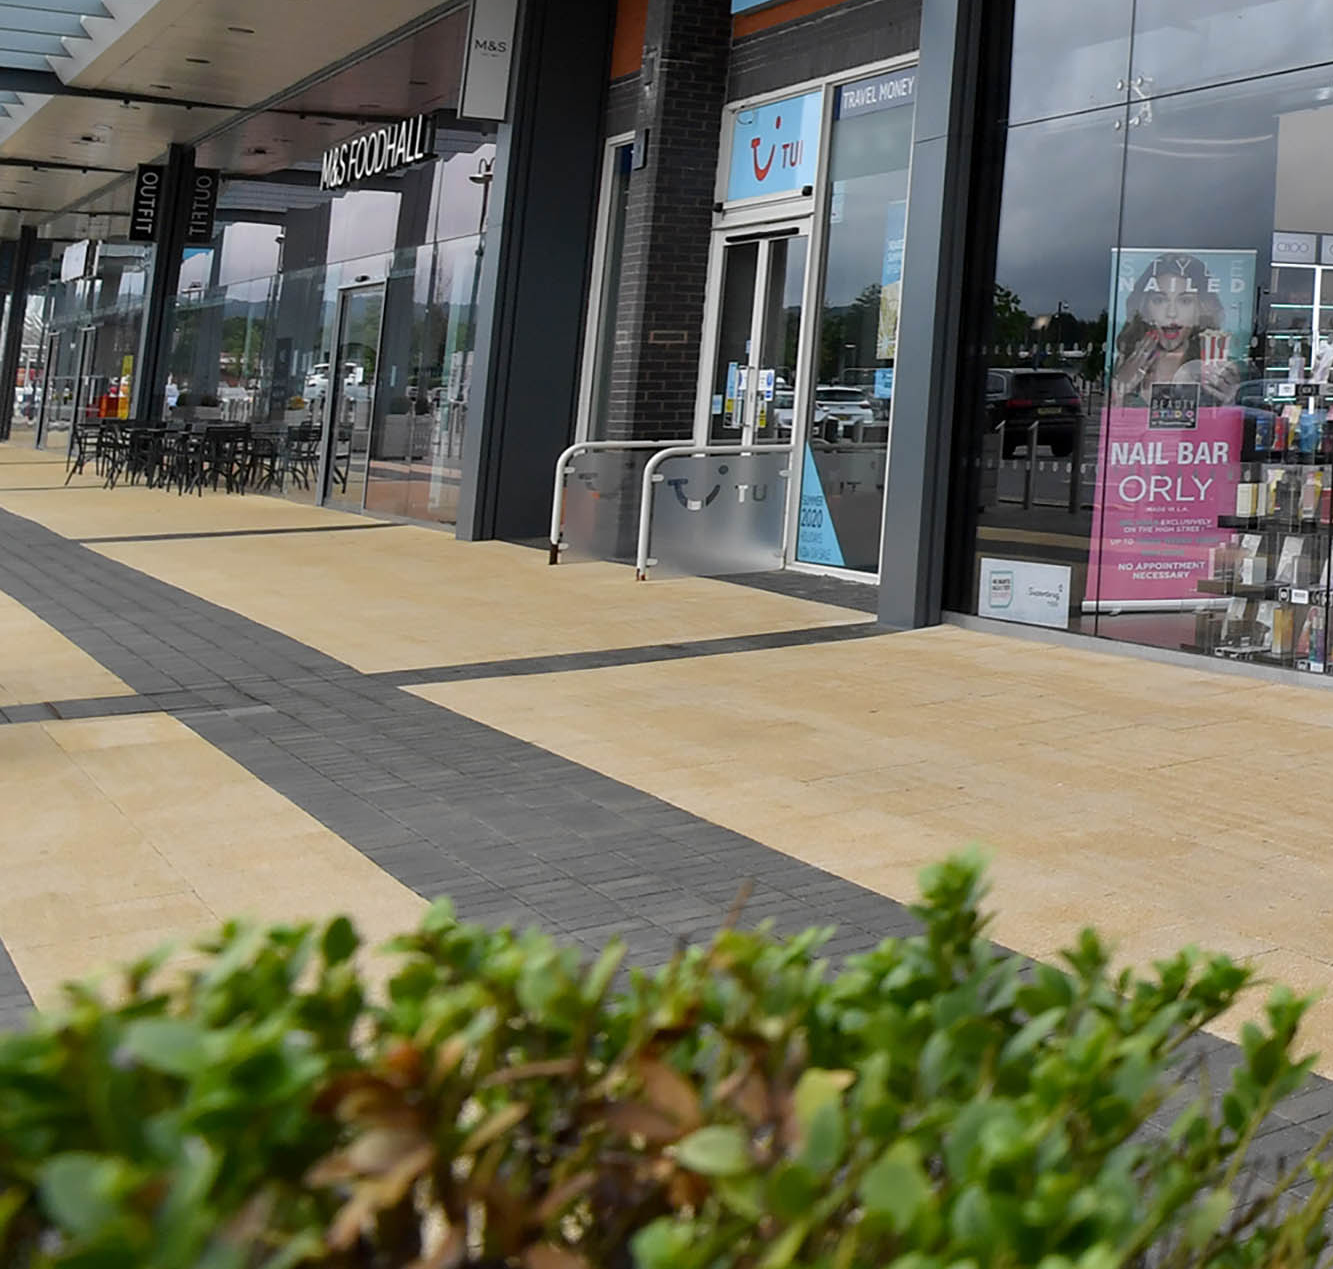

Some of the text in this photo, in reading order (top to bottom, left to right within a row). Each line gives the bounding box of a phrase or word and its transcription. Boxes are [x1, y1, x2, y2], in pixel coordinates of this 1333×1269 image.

[474, 39, 507, 52] M&S
[843, 77, 914, 109] TRAVEL MONEY
[319, 114, 424, 191] M&S FOODHALL
[782, 139, 803, 169] TUI
[133, 171, 160, 234] OUTFIT
[1121, 259, 1244, 279] STYLE
[1118, 278, 1246, 292] NAILED
[1152, 399, 1195, 410] BEAUTY
[1111, 441, 1229, 465] NAIL BAR
[1118, 475, 1214, 502] ORLY
[1118, 561, 1206, 571] NO APPOINTMENT
[1132, 571, 1191, 580] NECESSARY
